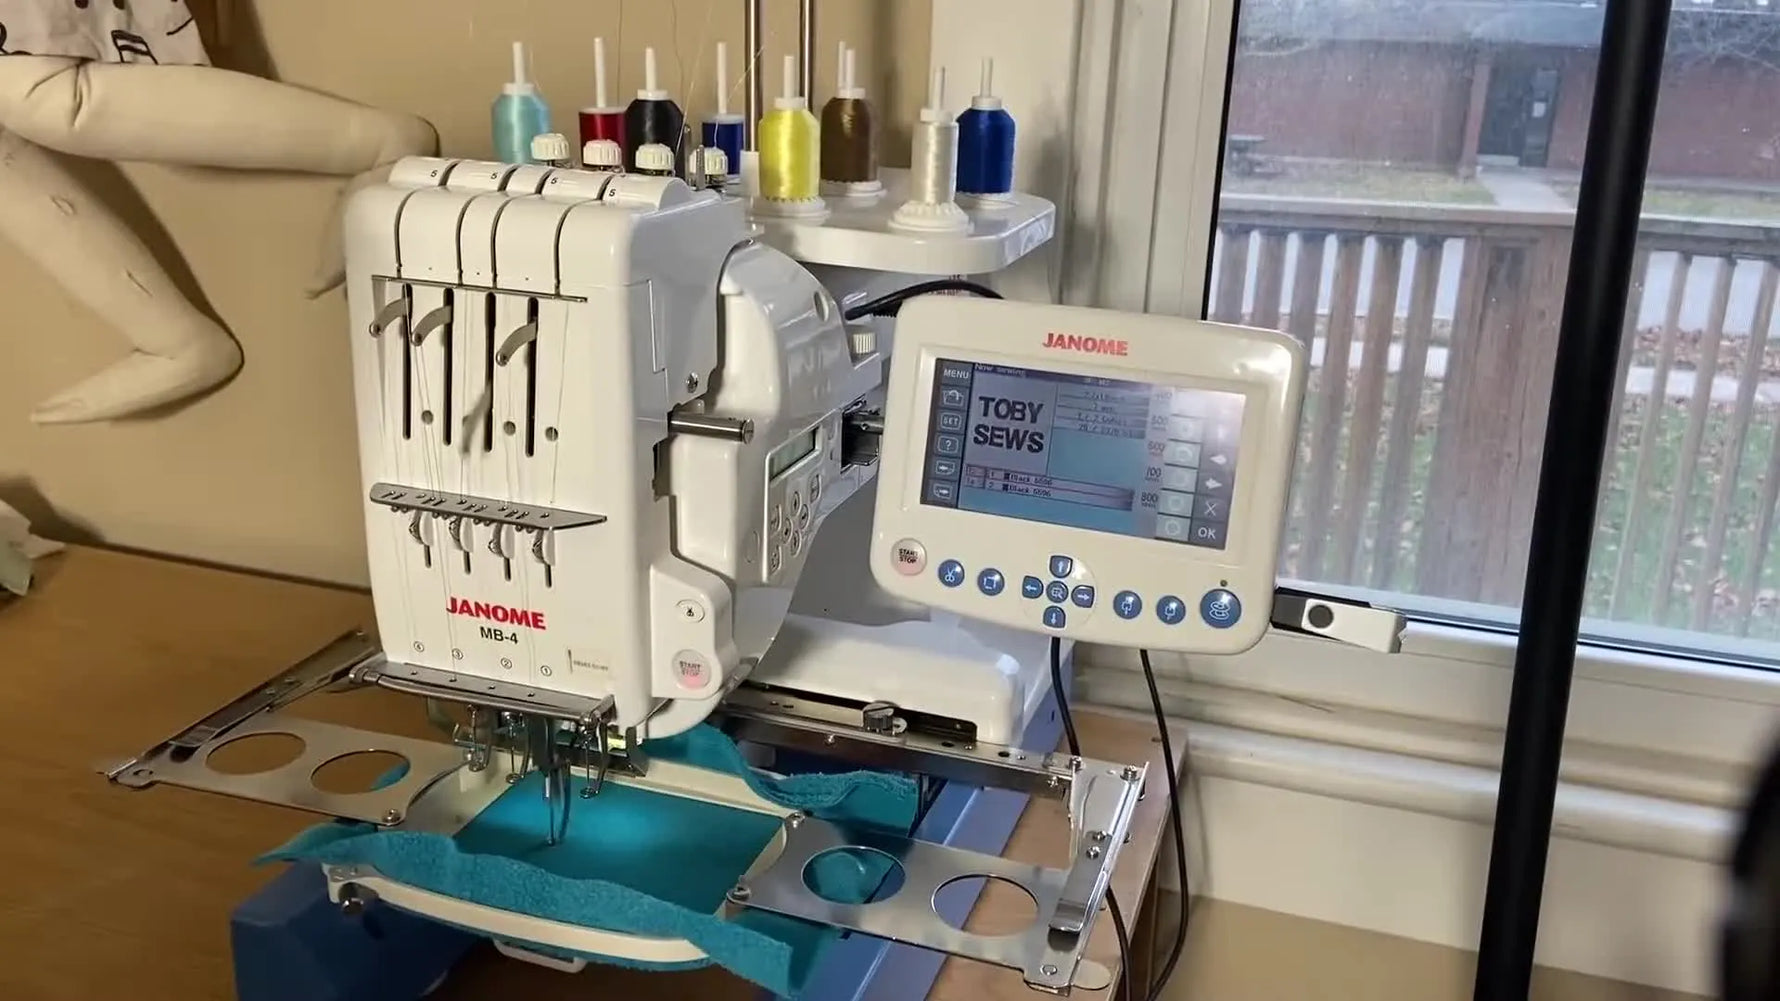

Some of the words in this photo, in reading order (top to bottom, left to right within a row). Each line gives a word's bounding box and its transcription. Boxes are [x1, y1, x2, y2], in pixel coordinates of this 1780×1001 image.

[430, 169, 438, 178] 5
[491, 172, 498, 180] 5
[551, 177, 558, 185] 5
[608, 188, 616, 197] 5
[1042, 332, 1128, 356] JANOME
[943, 368, 969, 379] MENU
[979, 396, 1044, 424] TOBY
[973, 424, 1045, 454] SEWS
[1198, 527, 1216, 540] OK
[446, 597, 547, 630] JANOME
[480, 626, 518, 645] MB-4
